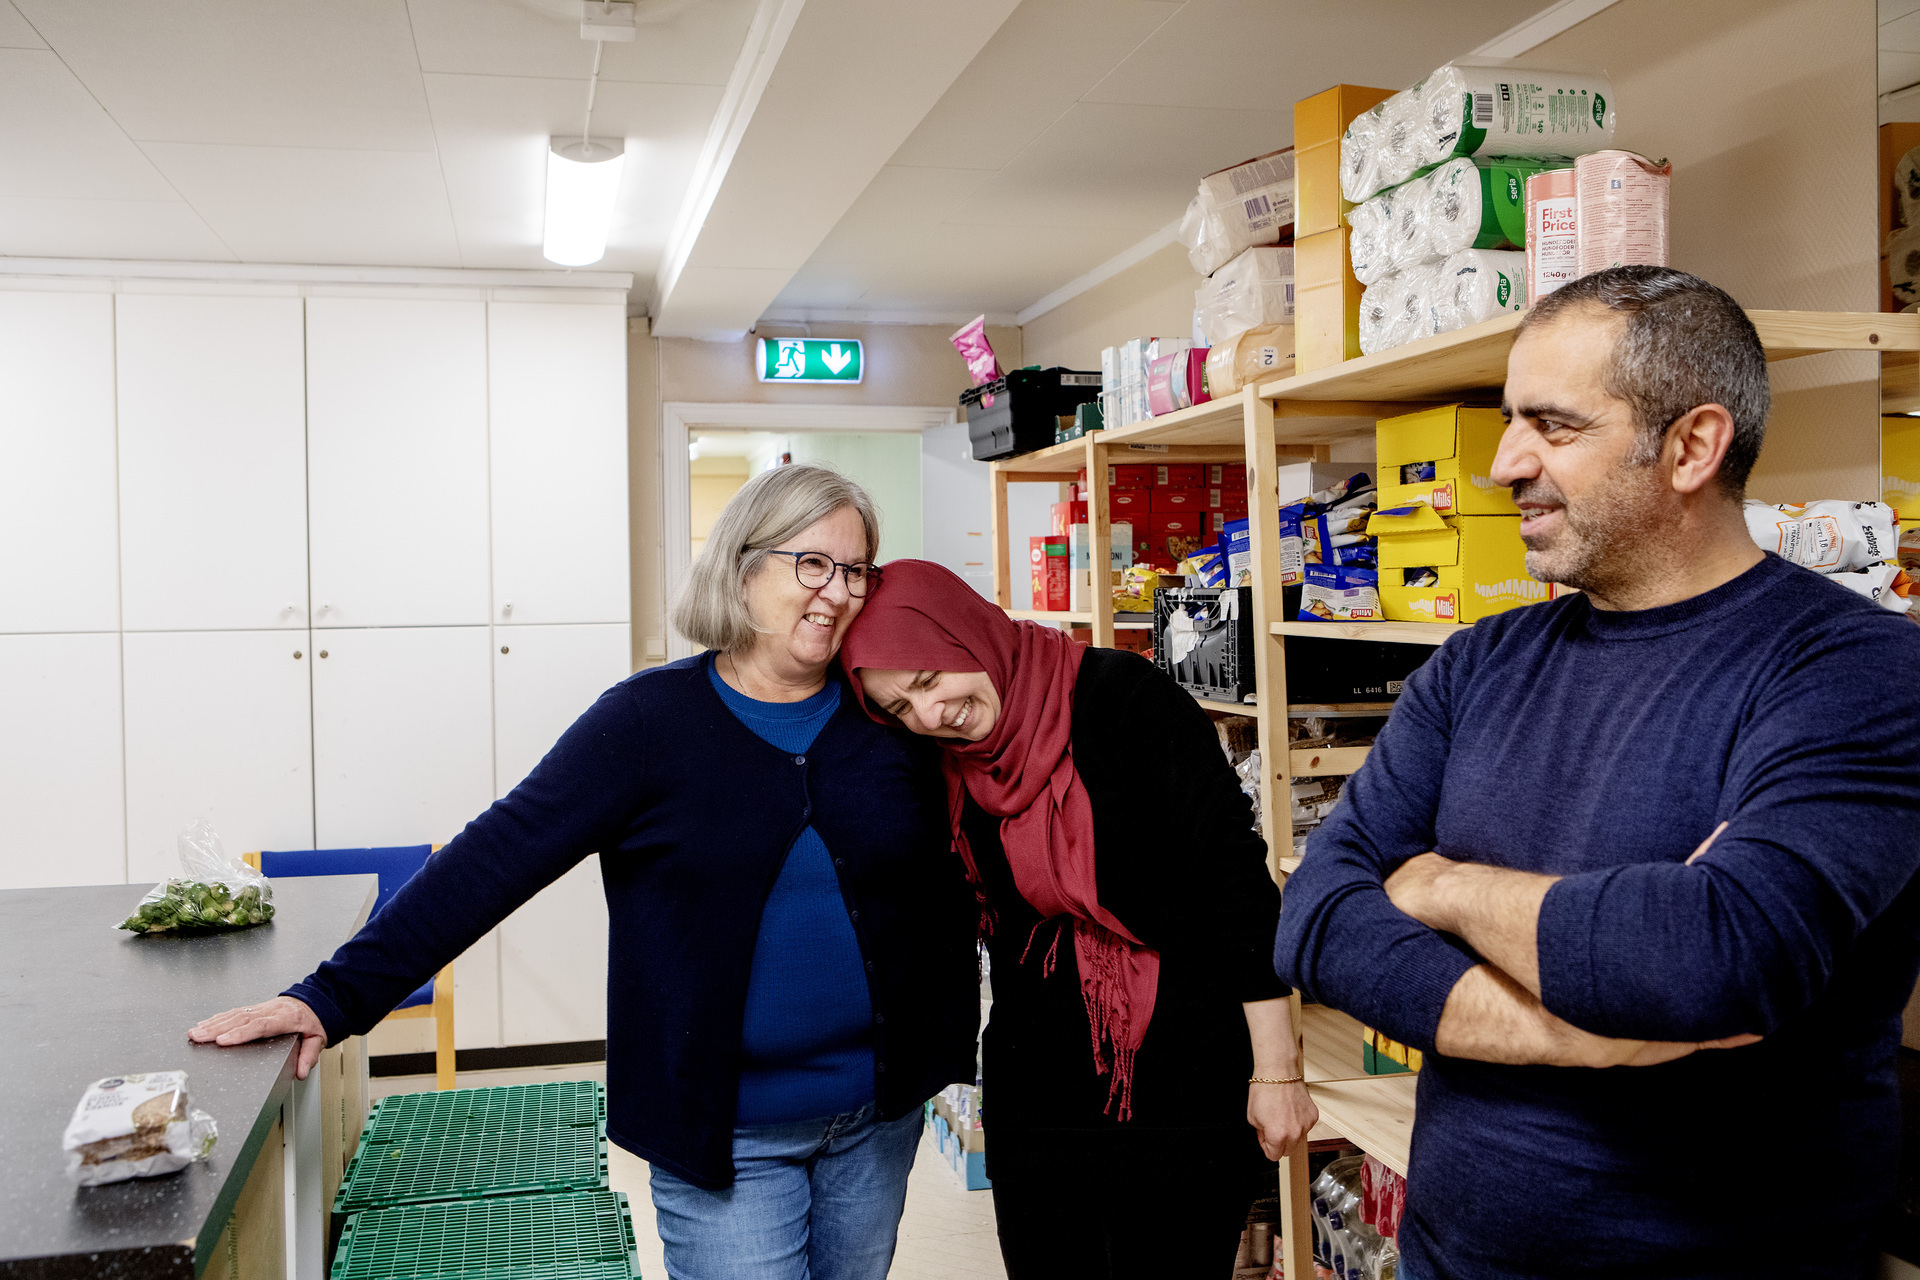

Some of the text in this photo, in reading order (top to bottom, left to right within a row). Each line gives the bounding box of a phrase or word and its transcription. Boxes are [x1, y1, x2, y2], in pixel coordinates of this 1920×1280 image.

[1595, 99, 1603, 121] serla
[1508, 178, 1518, 200] serla
[1542, 207, 1573, 220] First
[1542, 219, 1576, 232] Price
[1499, 278, 1508, 301] serla
[1264, 355, 1273, 366] 2
[1434, 491, 1451, 507] Mills
[1280, 572, 1295, 584] Mill
[1475, 578, 1546, 600] MMMMM
[1351, 608, 1373, 617] Mills
[1436, 599, 1454, 617] Mills
